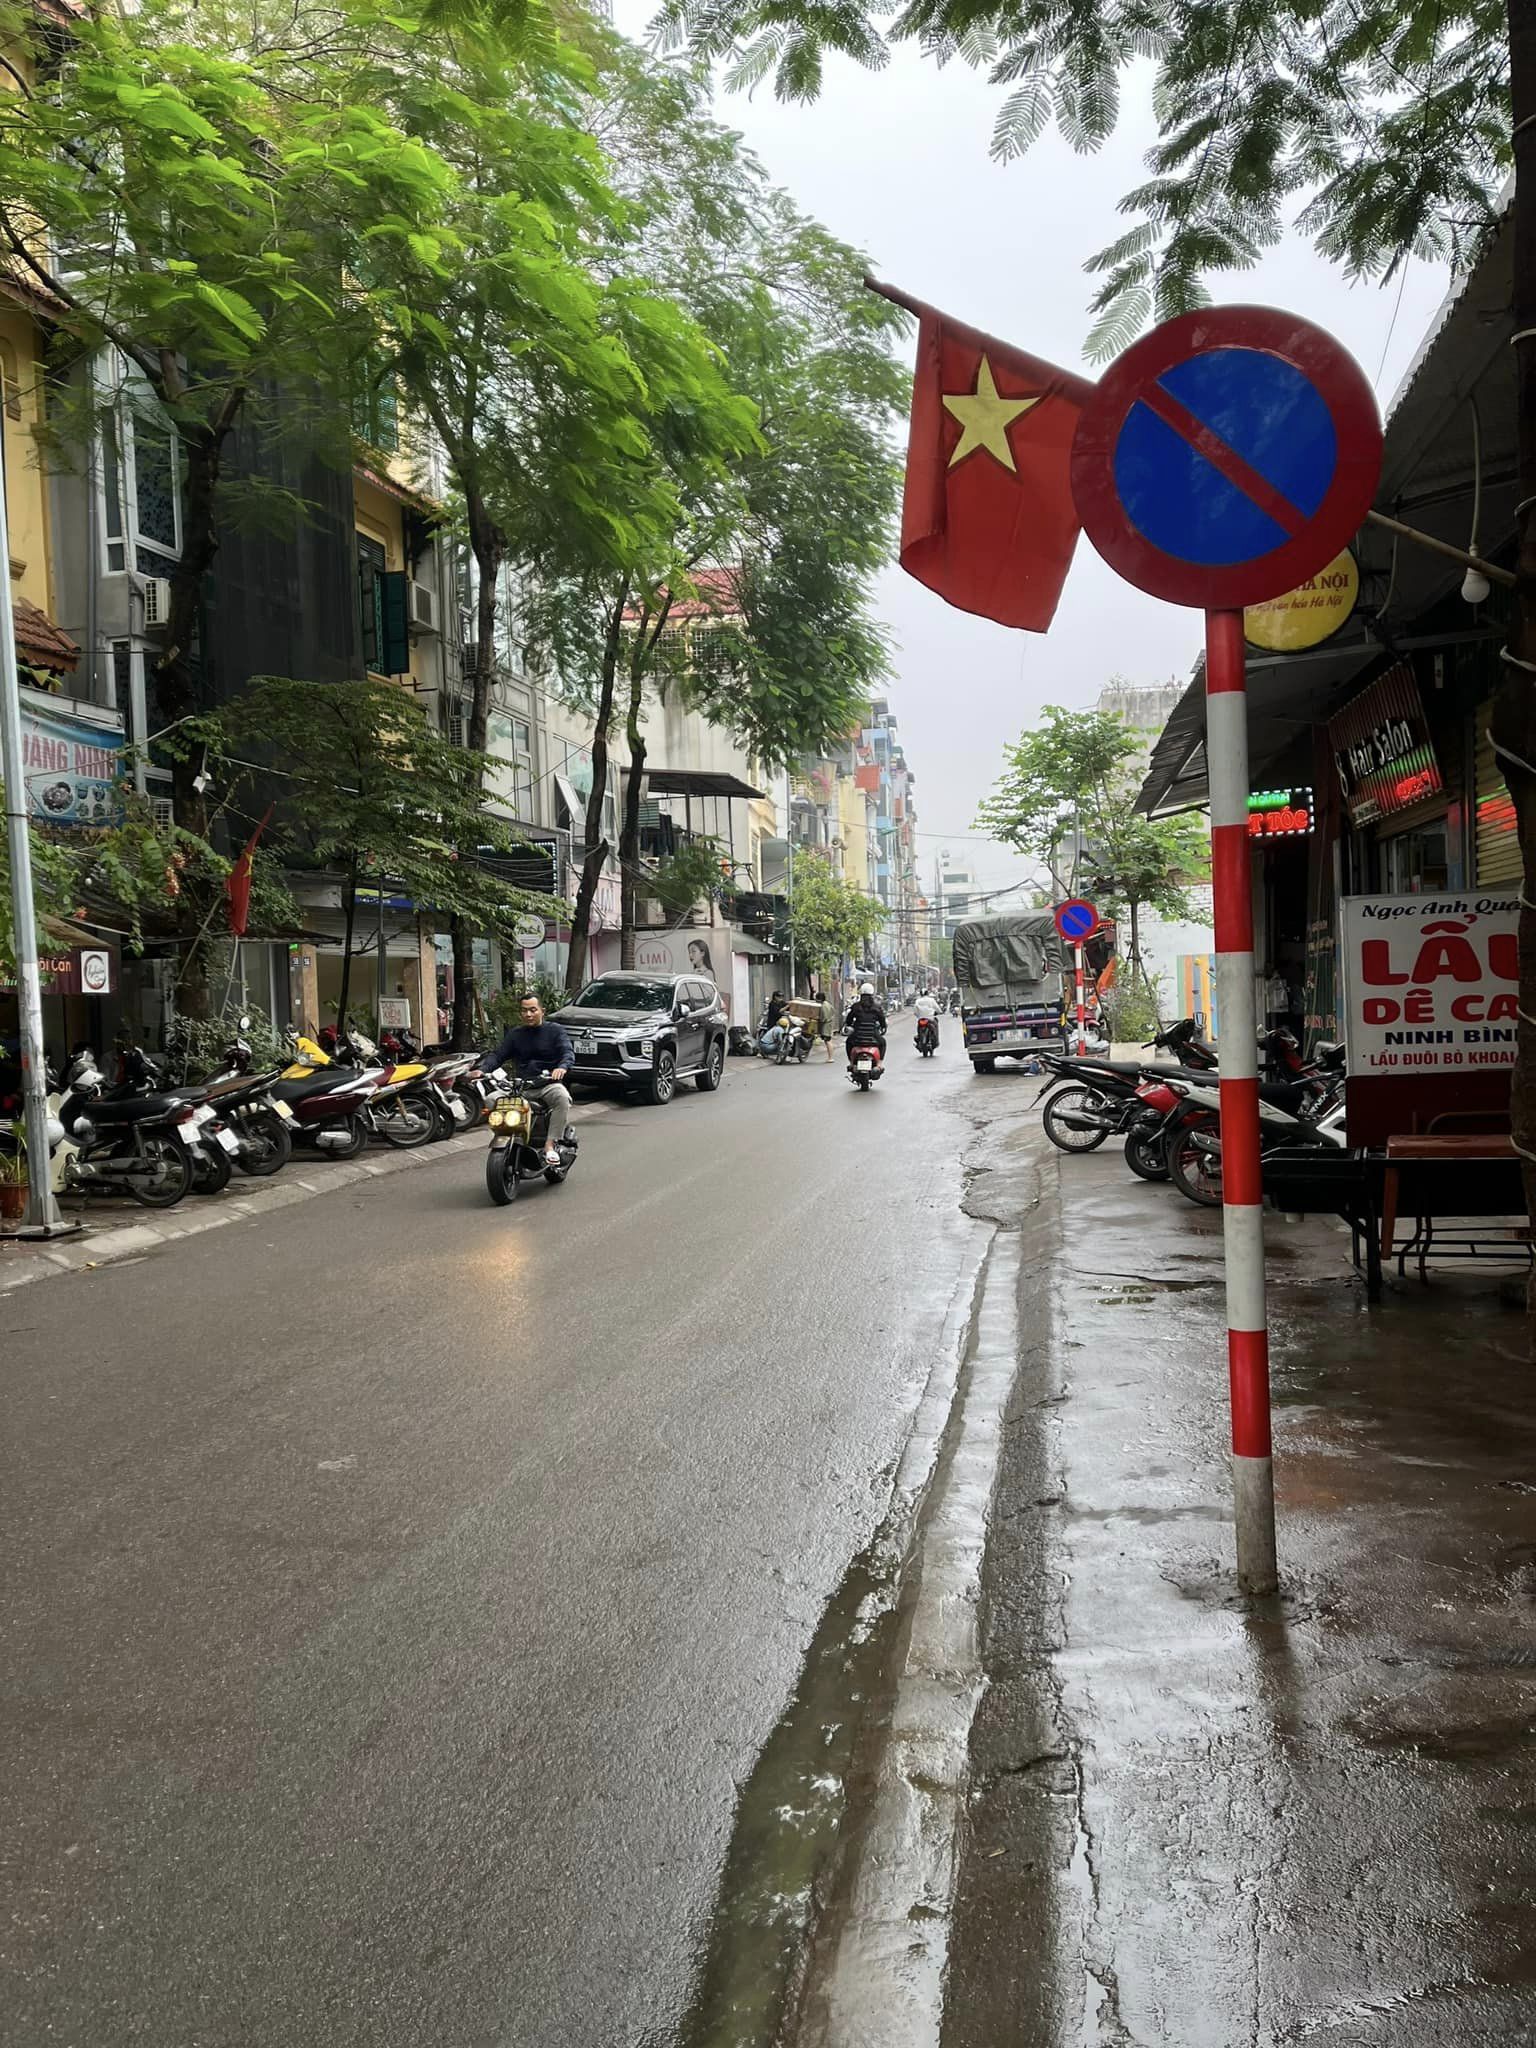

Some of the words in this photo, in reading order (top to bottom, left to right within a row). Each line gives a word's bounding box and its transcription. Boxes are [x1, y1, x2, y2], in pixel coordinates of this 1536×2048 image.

[1320, 571, 1350, 592] NỘI
[1310, 596, 1325, 608] Hà
[1348, 739, 1375, 780] Hair
[1373, 719, 1414, 766] Salon
[1266, 805, 1308, 831] TÓC
[1361, 904, 1417, 921] Ngọc
[1421, 900, 1468, 915] Anh
[1362, 988, 1436, 1025] DÊ
[1385, 1030, 1453, 1045] NINH
[1464, 1026, 1518, 1043] BÌN
[1370, 1048, 1398, 1066] LẨU
[1403, 1049, 1438, 1065] ĐUÔI
[1444, 1048, 1463, 1065] BÒ
[1469, 1050, 1515, 1065] KHOAI
